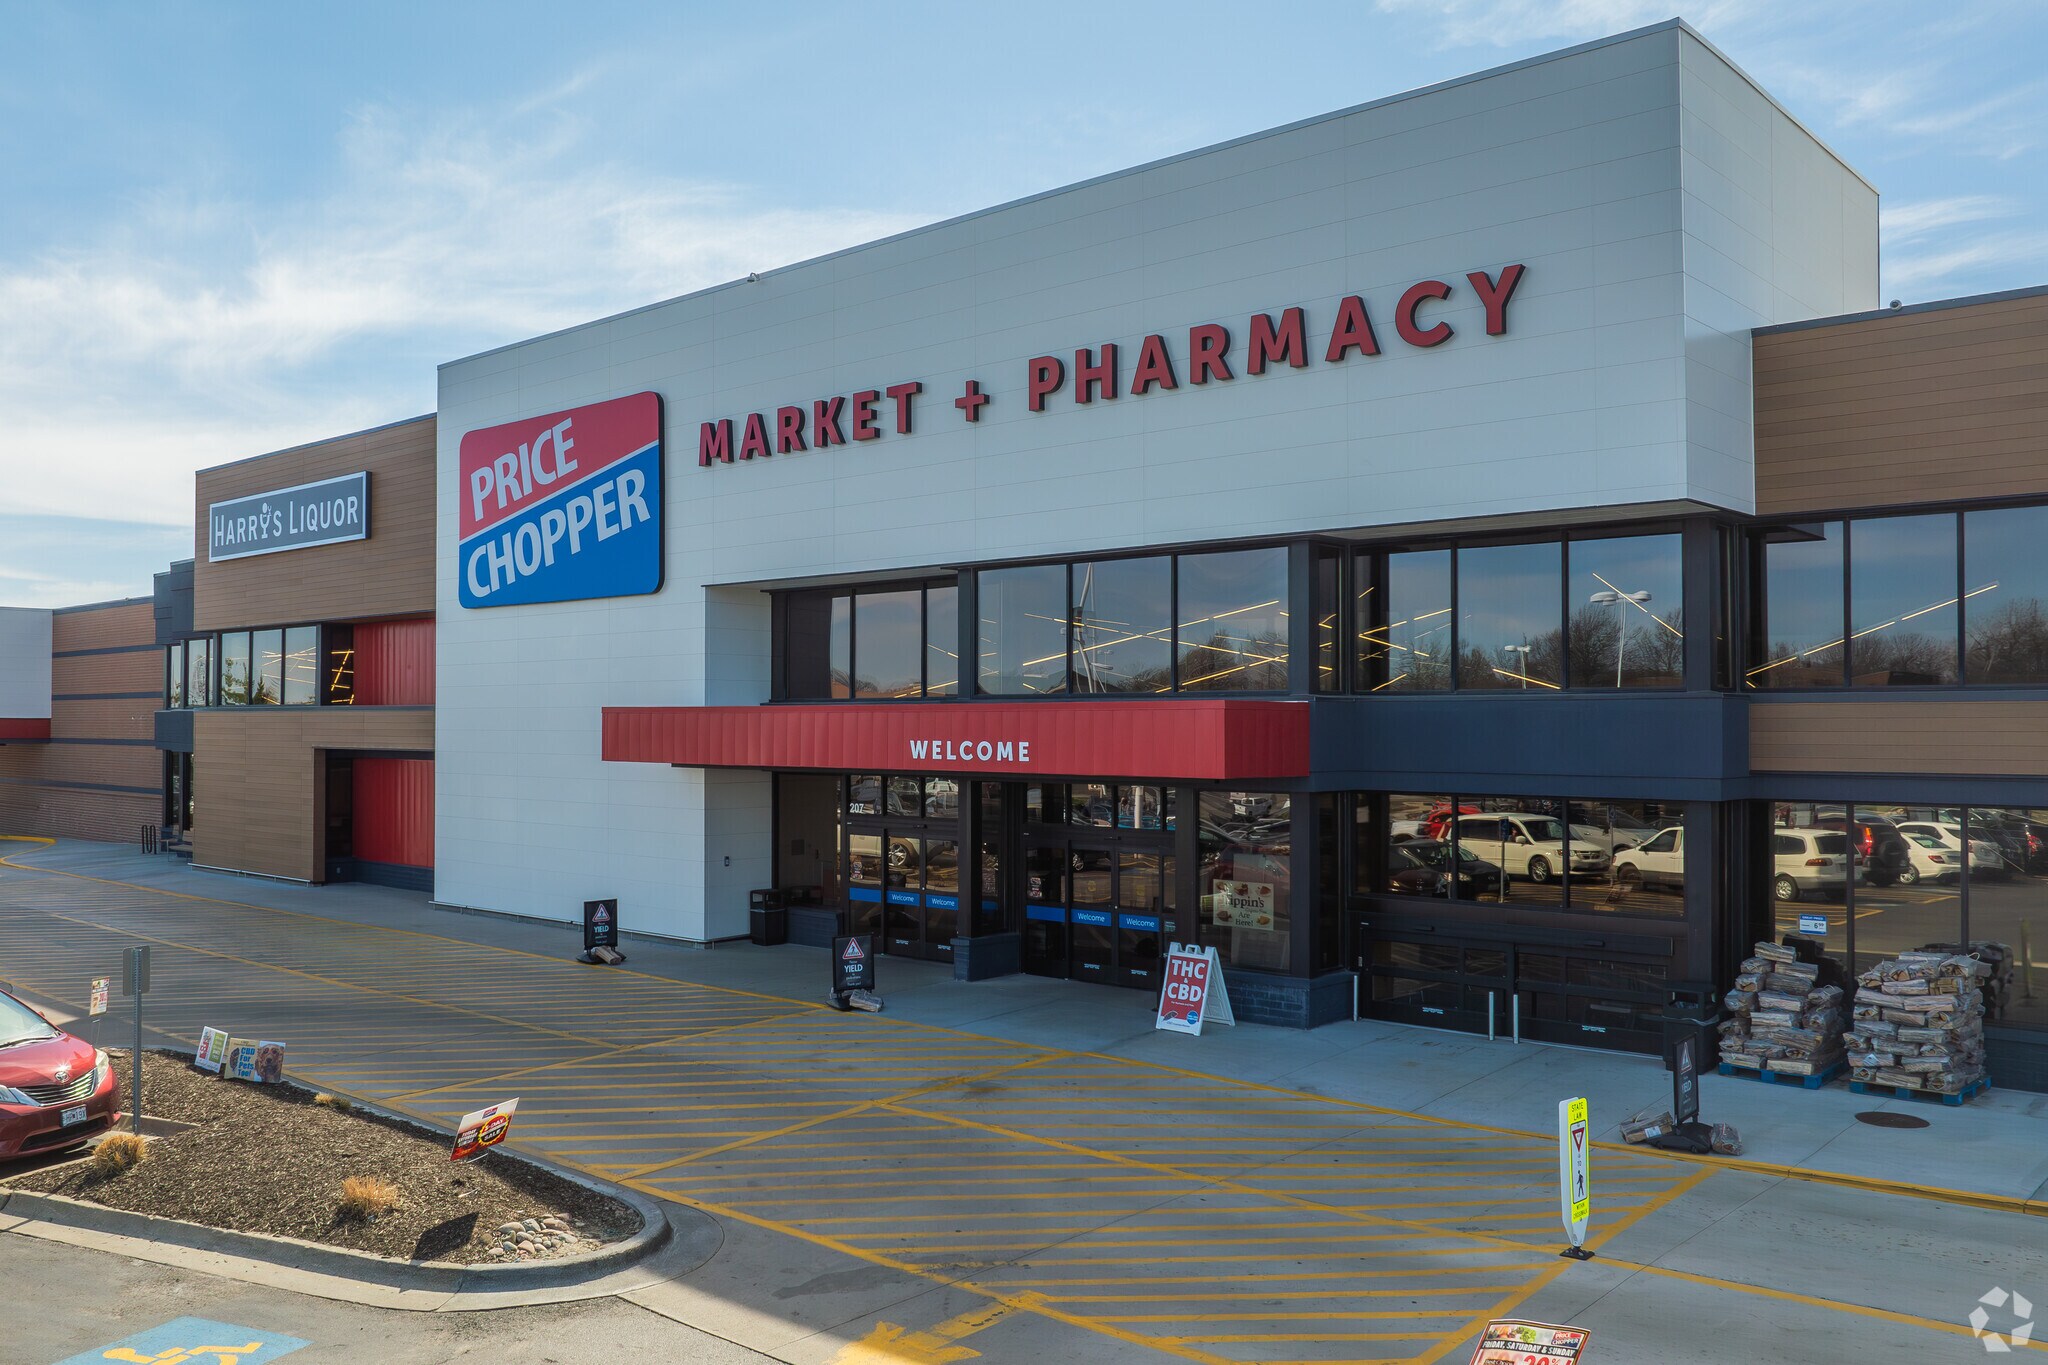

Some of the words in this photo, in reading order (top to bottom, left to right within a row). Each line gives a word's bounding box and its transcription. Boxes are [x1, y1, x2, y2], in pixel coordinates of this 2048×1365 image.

[699, 381, 922, 467] MARKET
[1028, 263, 1526, 413] PHARMACY
[470, 417, 578, 522] PRICE
[289, 496, 358, 535] LIQUOR
[467, 468, 651, 598] CHOPPER
[910, 740, 1030, 762] WELCOME
[891, 893, 914, 902] Welcome
[932, 897, 955, 907] Welcome
[1077, 912, 1105, 922] Welcome
[1126, 917, 1155, 927] Welcome
[594, 925, 609, 933] YIELD
[844, 964, 863, 973] YIELD
[1171, 960, 1206, 980] THC
[1167, 982, 1202, 1002] CBD
[1571, 1101, 1584, 1112] STATE
[1573, 1112, 1582, 1121] LAW
[484, 1129, 501, 1141] SALE
[1551, 1338, 1579, 1346] CHOPPER
[1482, 1340, 1505, 1349] FRIDAY,
[1507, 1341, 1541, 1353] SATURDAY
[1541, 1345, 1548, 1354] &
[1548, 1346, 1576, 1357] SUNDAY
